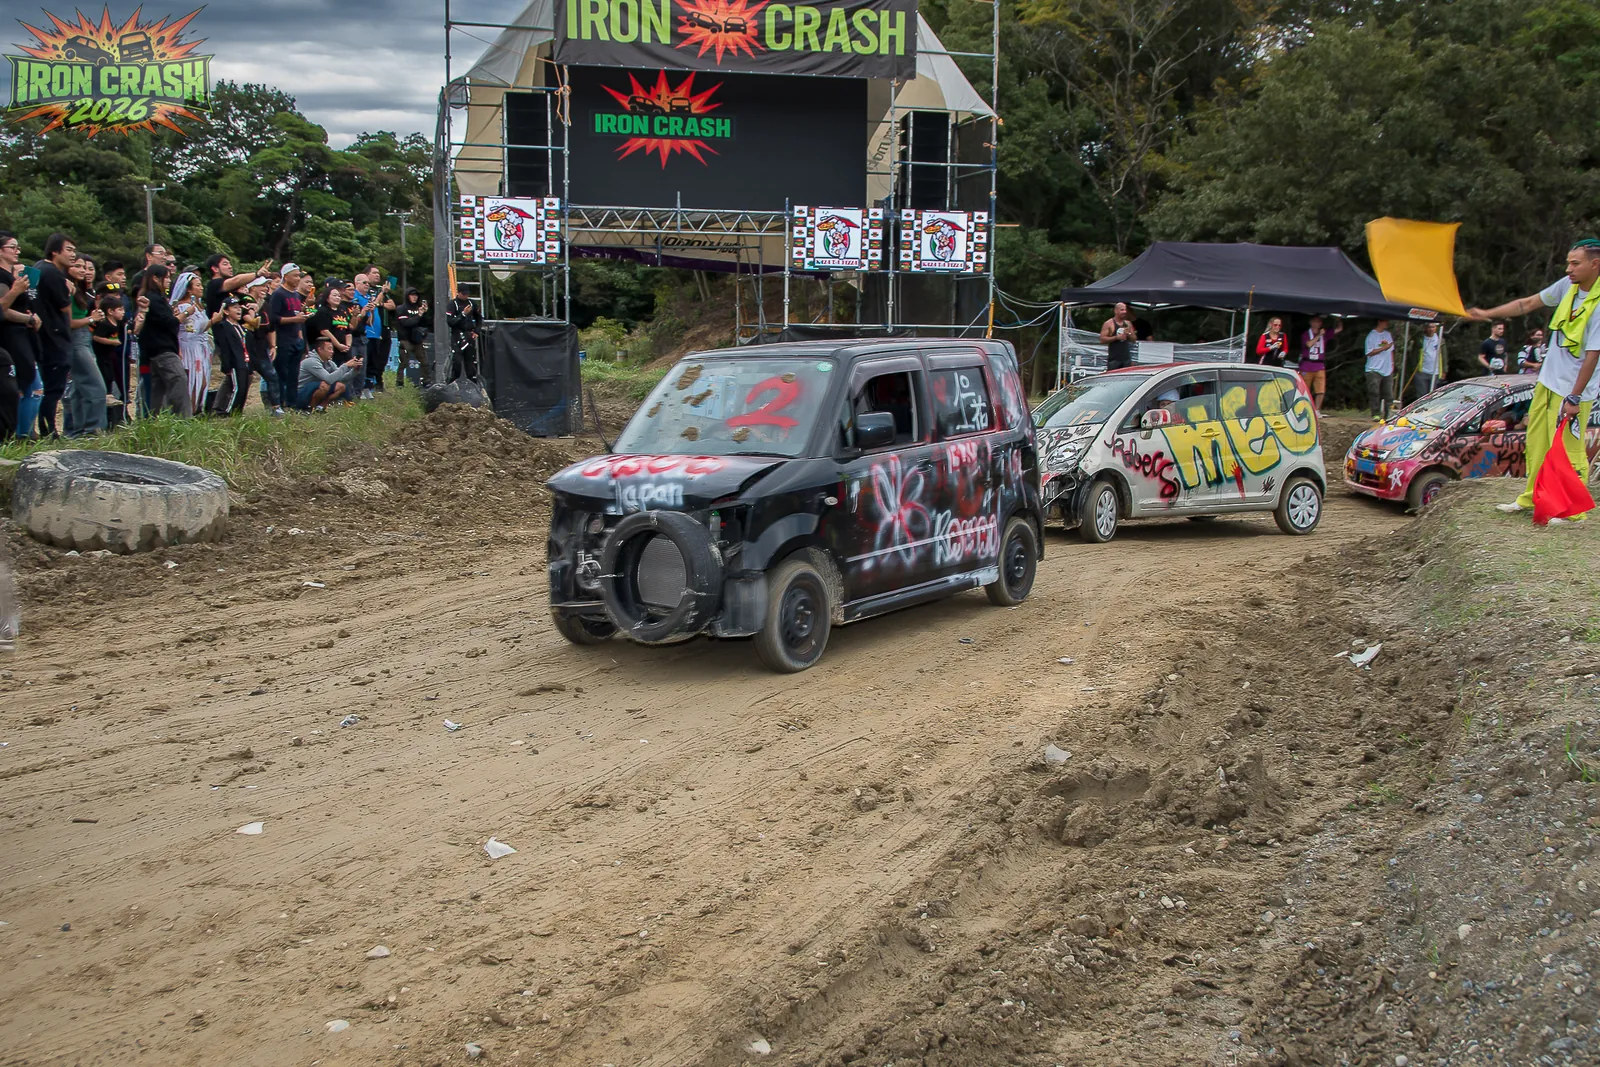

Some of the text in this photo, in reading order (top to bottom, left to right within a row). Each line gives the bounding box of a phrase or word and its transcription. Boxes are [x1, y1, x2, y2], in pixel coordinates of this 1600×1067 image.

[566, 0, 906, 56] IRON CRASH
[595, 113, 731, 138] IRON CRASH
[727, 375, 801, 427] 2
[1068, 410, 1099, 426] 12
